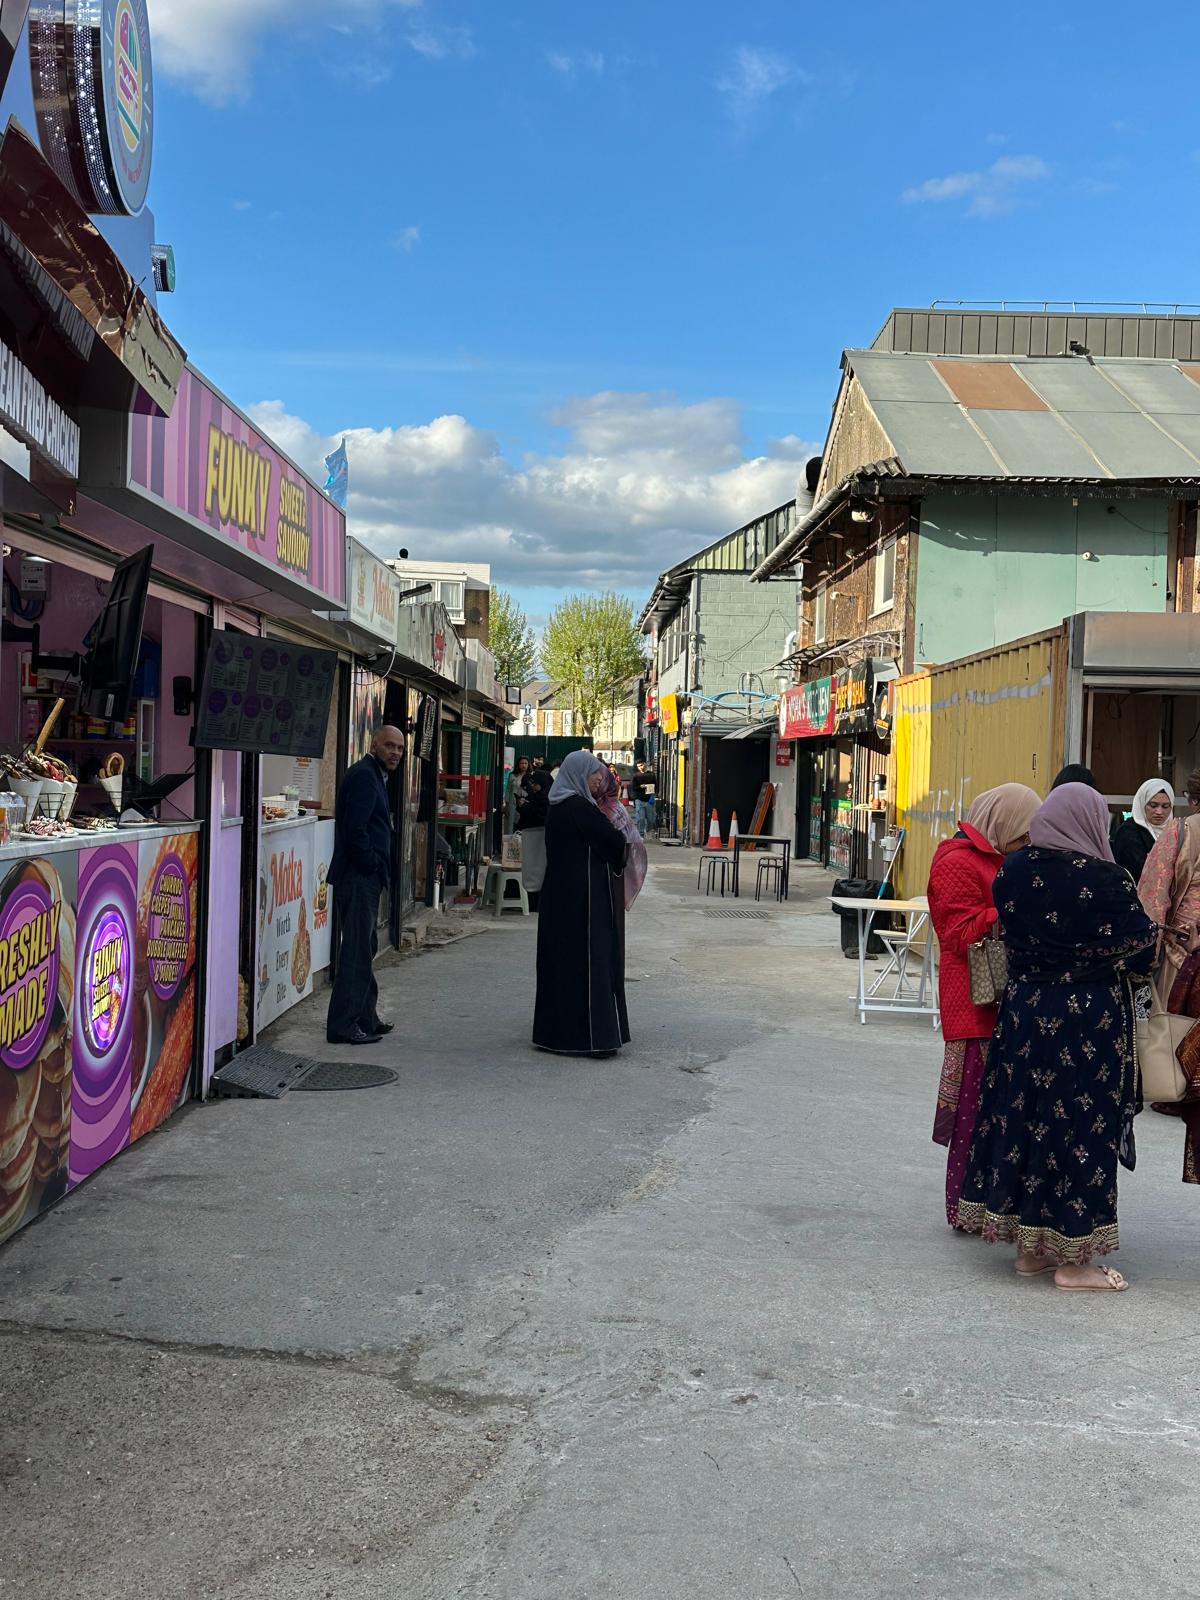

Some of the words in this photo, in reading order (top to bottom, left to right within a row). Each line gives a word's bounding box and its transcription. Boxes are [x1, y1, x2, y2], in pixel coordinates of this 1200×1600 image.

[0, 336, 23, 424] EAN
[21, 364, 46, 446] FRIED
[46, 394, 81, 479] CHICKEN
[205, 425, 272, 538] FUNKY
[279, 477, 304, 527] SWEET
[277, 519, 311, 572] SAVOURY
[160, 874, 183, 895] CHURROS
[268, 848, 303, 925] Motka
[160, 918, 186, 939] PANCAKES
[276, 911, 291, 938] Worth
[93, 935, 123, 986] FUNKY
[146, 939, 167, 959] BUBBLE
[166, 941, 188, 961] WAFFLES
[275, 949, 289, 972] Every
[0, 967, 48, 1050] MADE
[276, 982, 287, 1004] Bite
